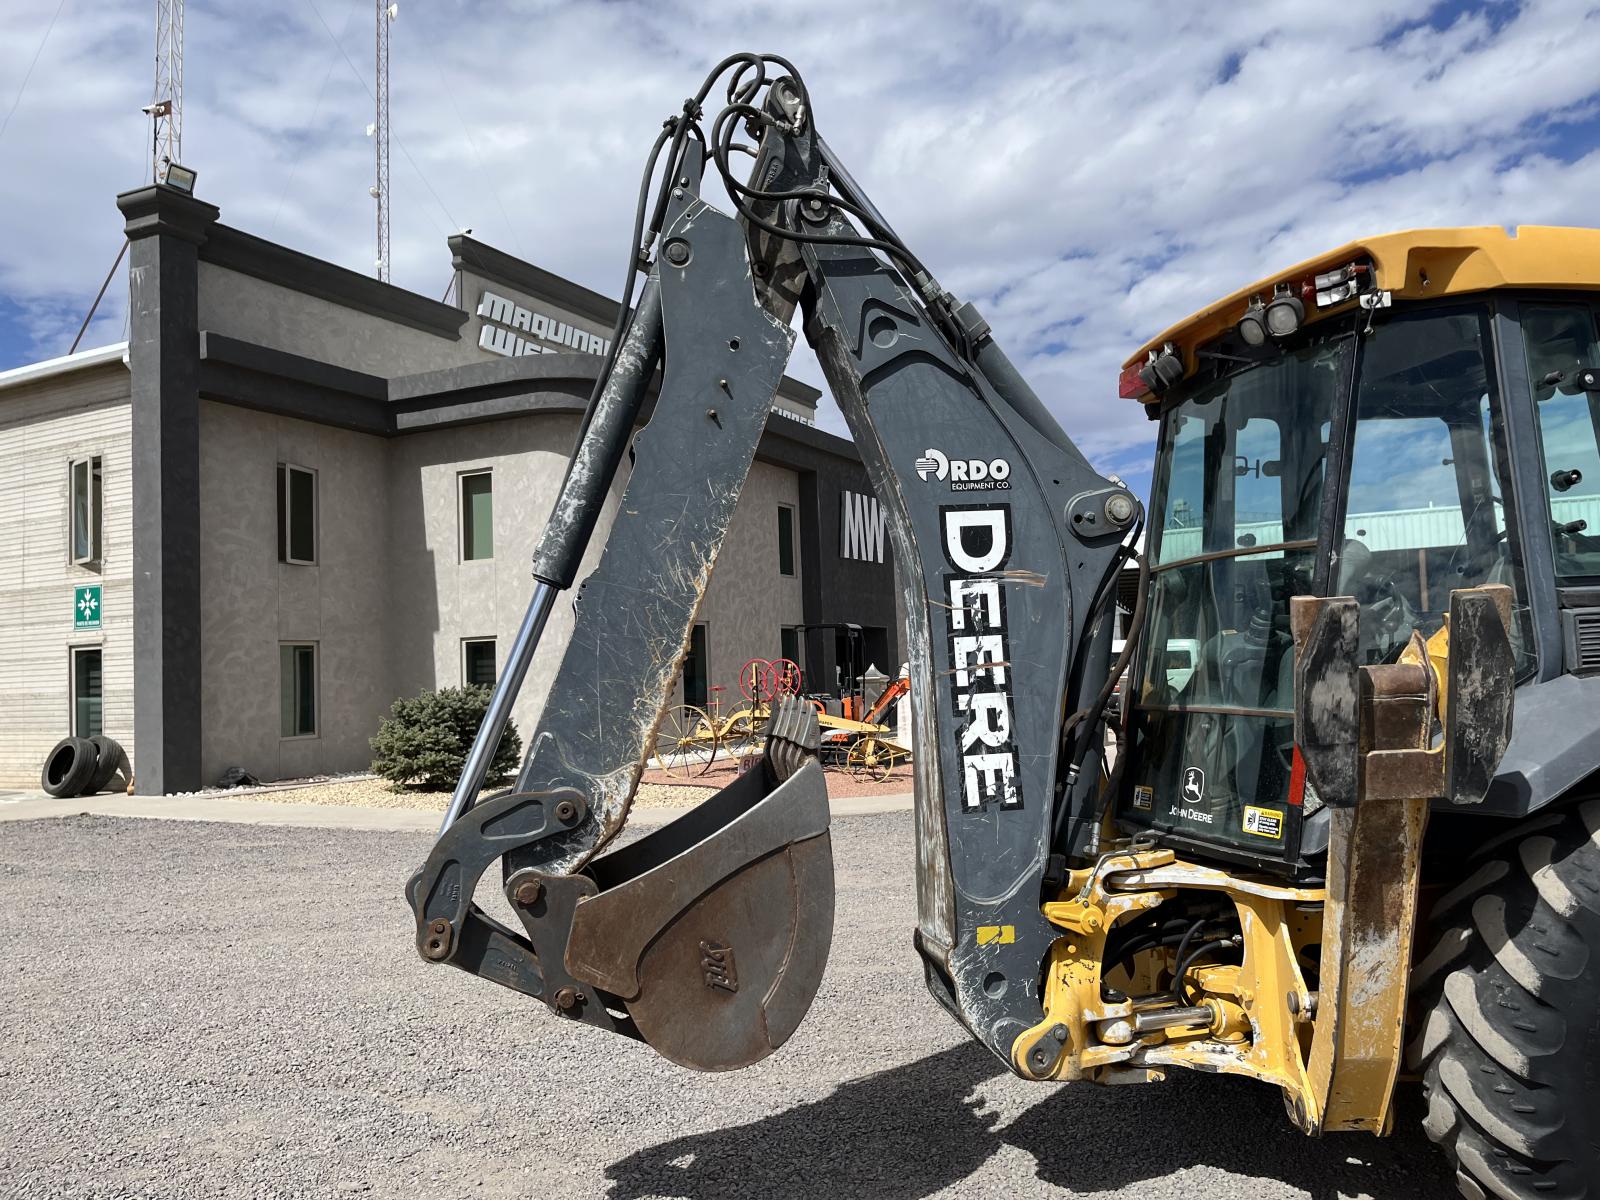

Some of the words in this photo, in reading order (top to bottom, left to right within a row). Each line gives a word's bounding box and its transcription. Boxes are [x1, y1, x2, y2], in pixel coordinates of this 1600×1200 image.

[952, 482, 995, 491] EQUIPMENT
[996, 481, 1011, 489] CO.
[841, 490, 885, 564] MW
[945, 510, 1018, 806] DEERE
[1168, 805, 1188, 819] JOHN
[1187, 808, 1213, 824] DEERE
